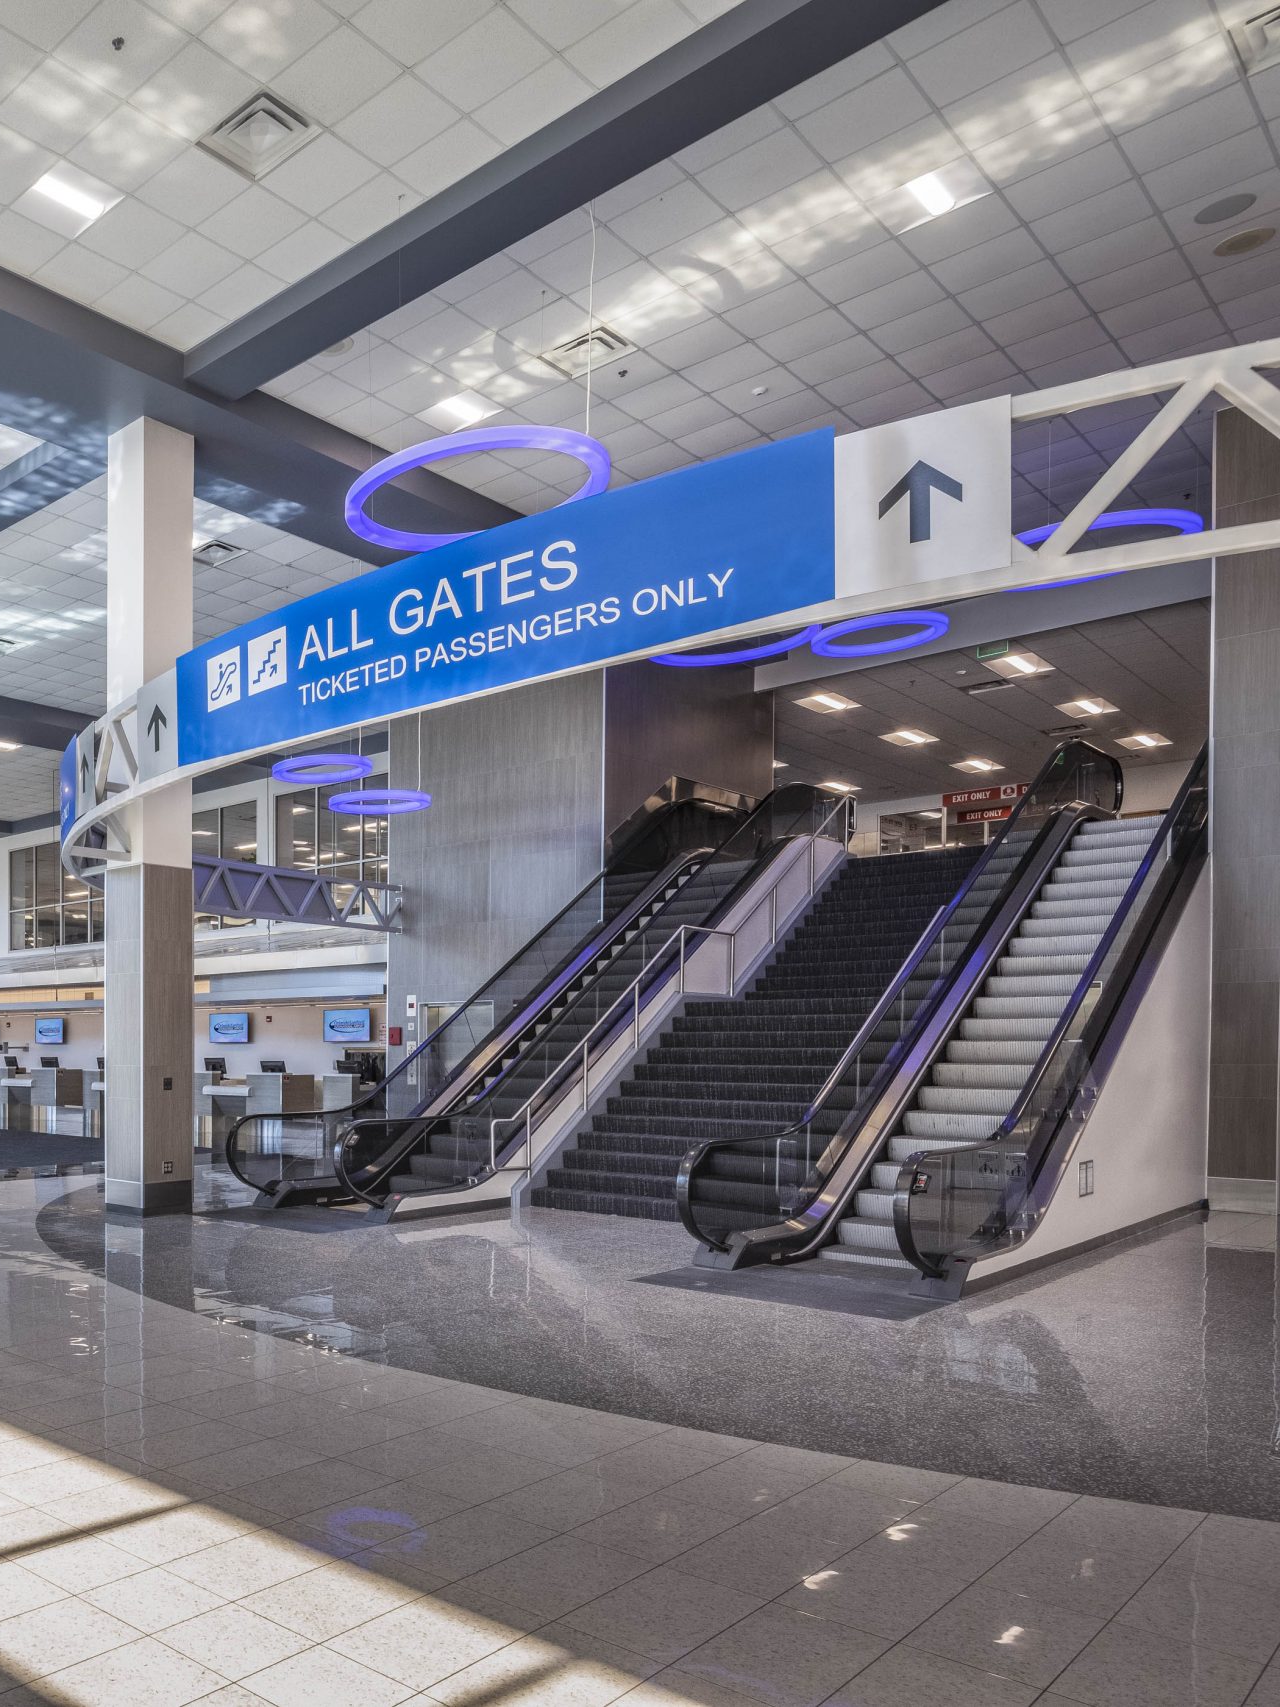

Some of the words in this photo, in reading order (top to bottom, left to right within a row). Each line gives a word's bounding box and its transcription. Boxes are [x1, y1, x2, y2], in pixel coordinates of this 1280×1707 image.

[298, 609, 374, 669] ALL
[389, 540, 578, 635] GATES
[298, 654, 407, 706] TICKETED
[415, 596, 621, 672] PASSENGERS
[631, 568, 734, 617] ONLY
[952, 794, 969, 803] EXIT
[970, 790, 991, 800] ONLY
[966, 812, 982, 820] EXIT
[983, 809, 1003, 818] ONLY
